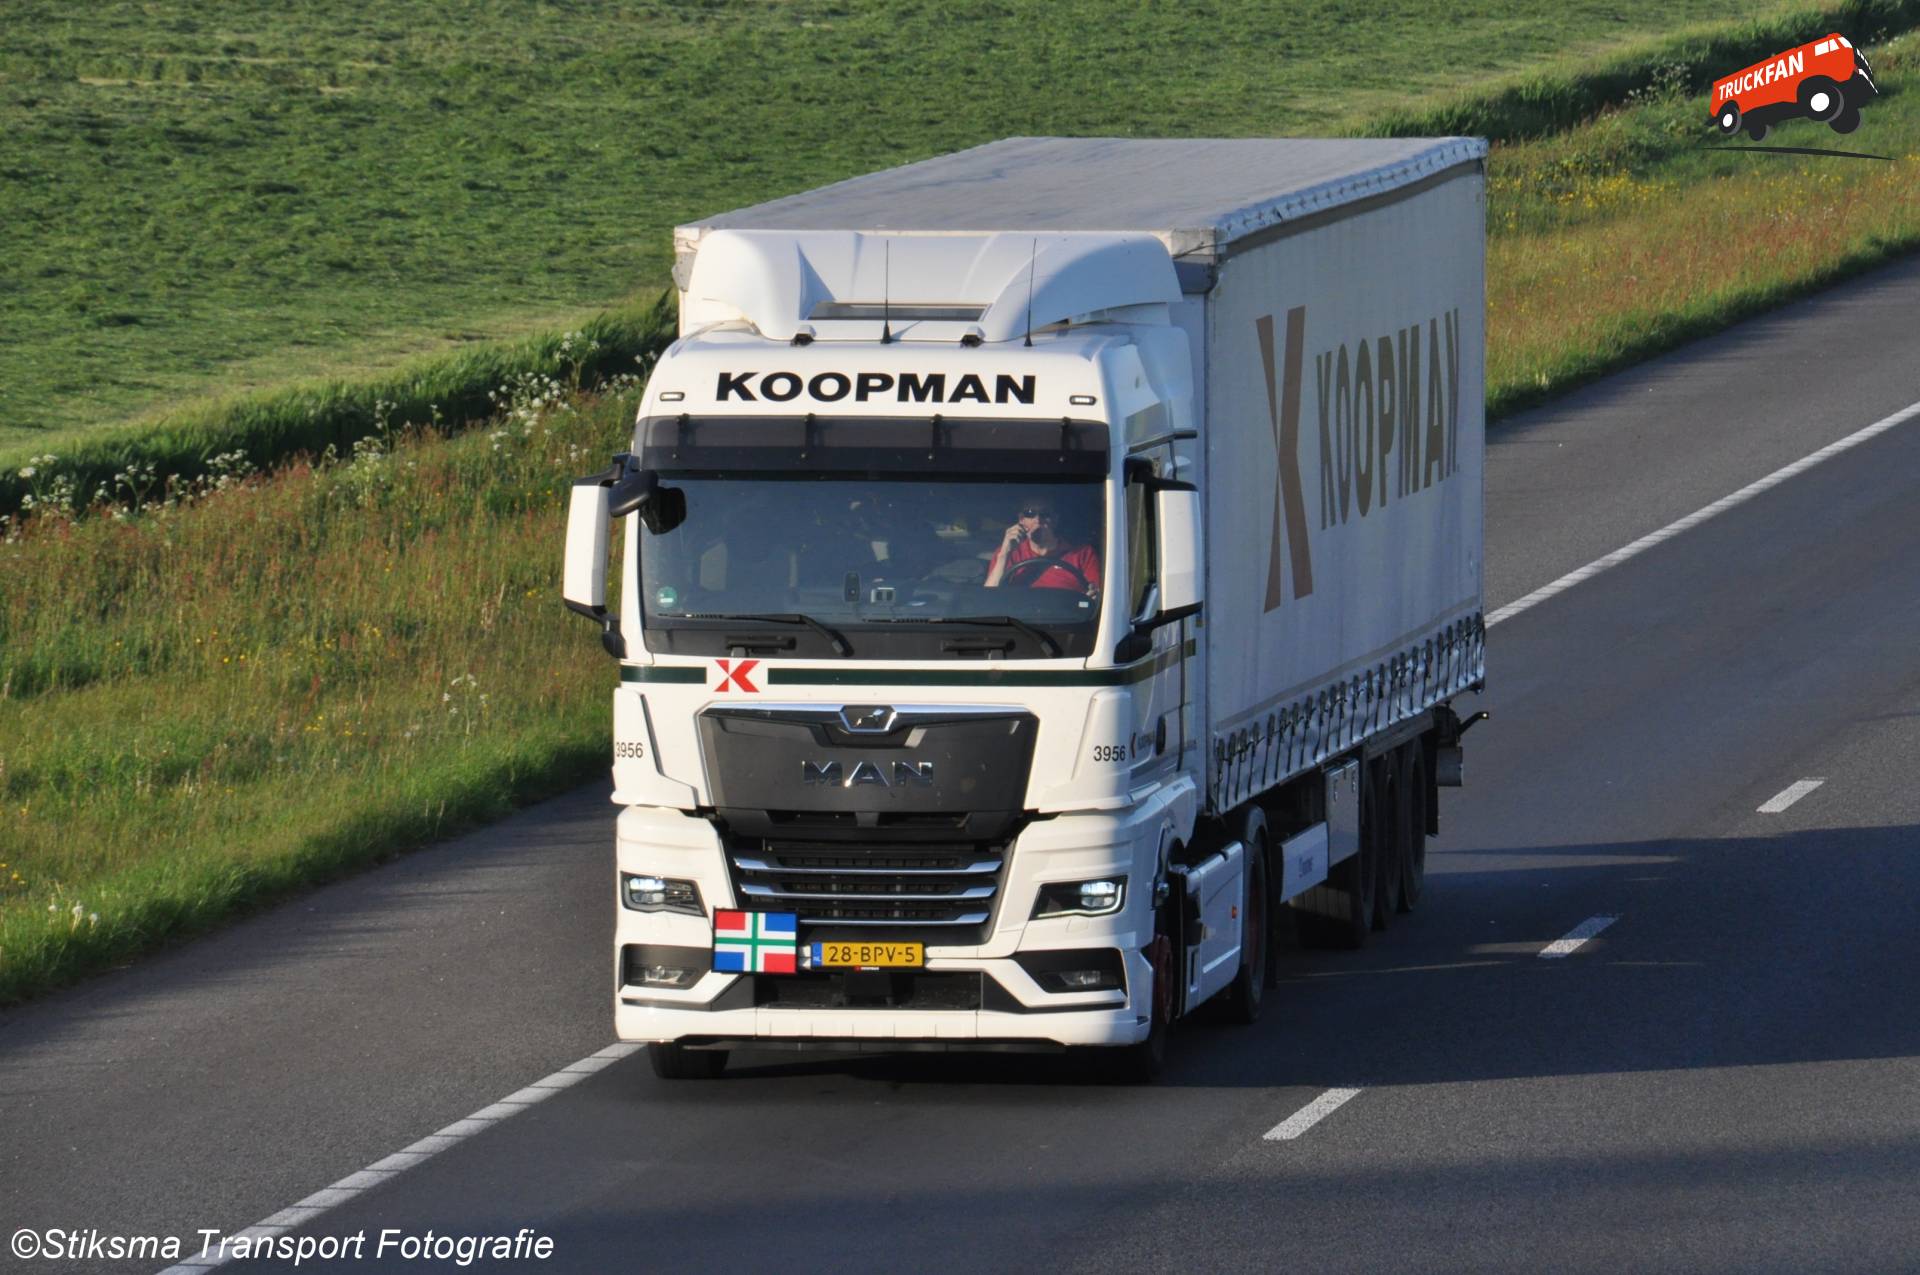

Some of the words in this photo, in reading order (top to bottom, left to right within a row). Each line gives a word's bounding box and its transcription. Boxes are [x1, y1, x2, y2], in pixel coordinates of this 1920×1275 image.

[715, 371, 1037, 404] KOOPMAN
[1316, 308, 1459, 530] KOOPMAN
[616, 742, 643, 758] 3956
[1093, 745, 1126, 761] 3956
[802, 761, 933, 787] MAN
[828, 946, 916, 962] 28-BPV-5
